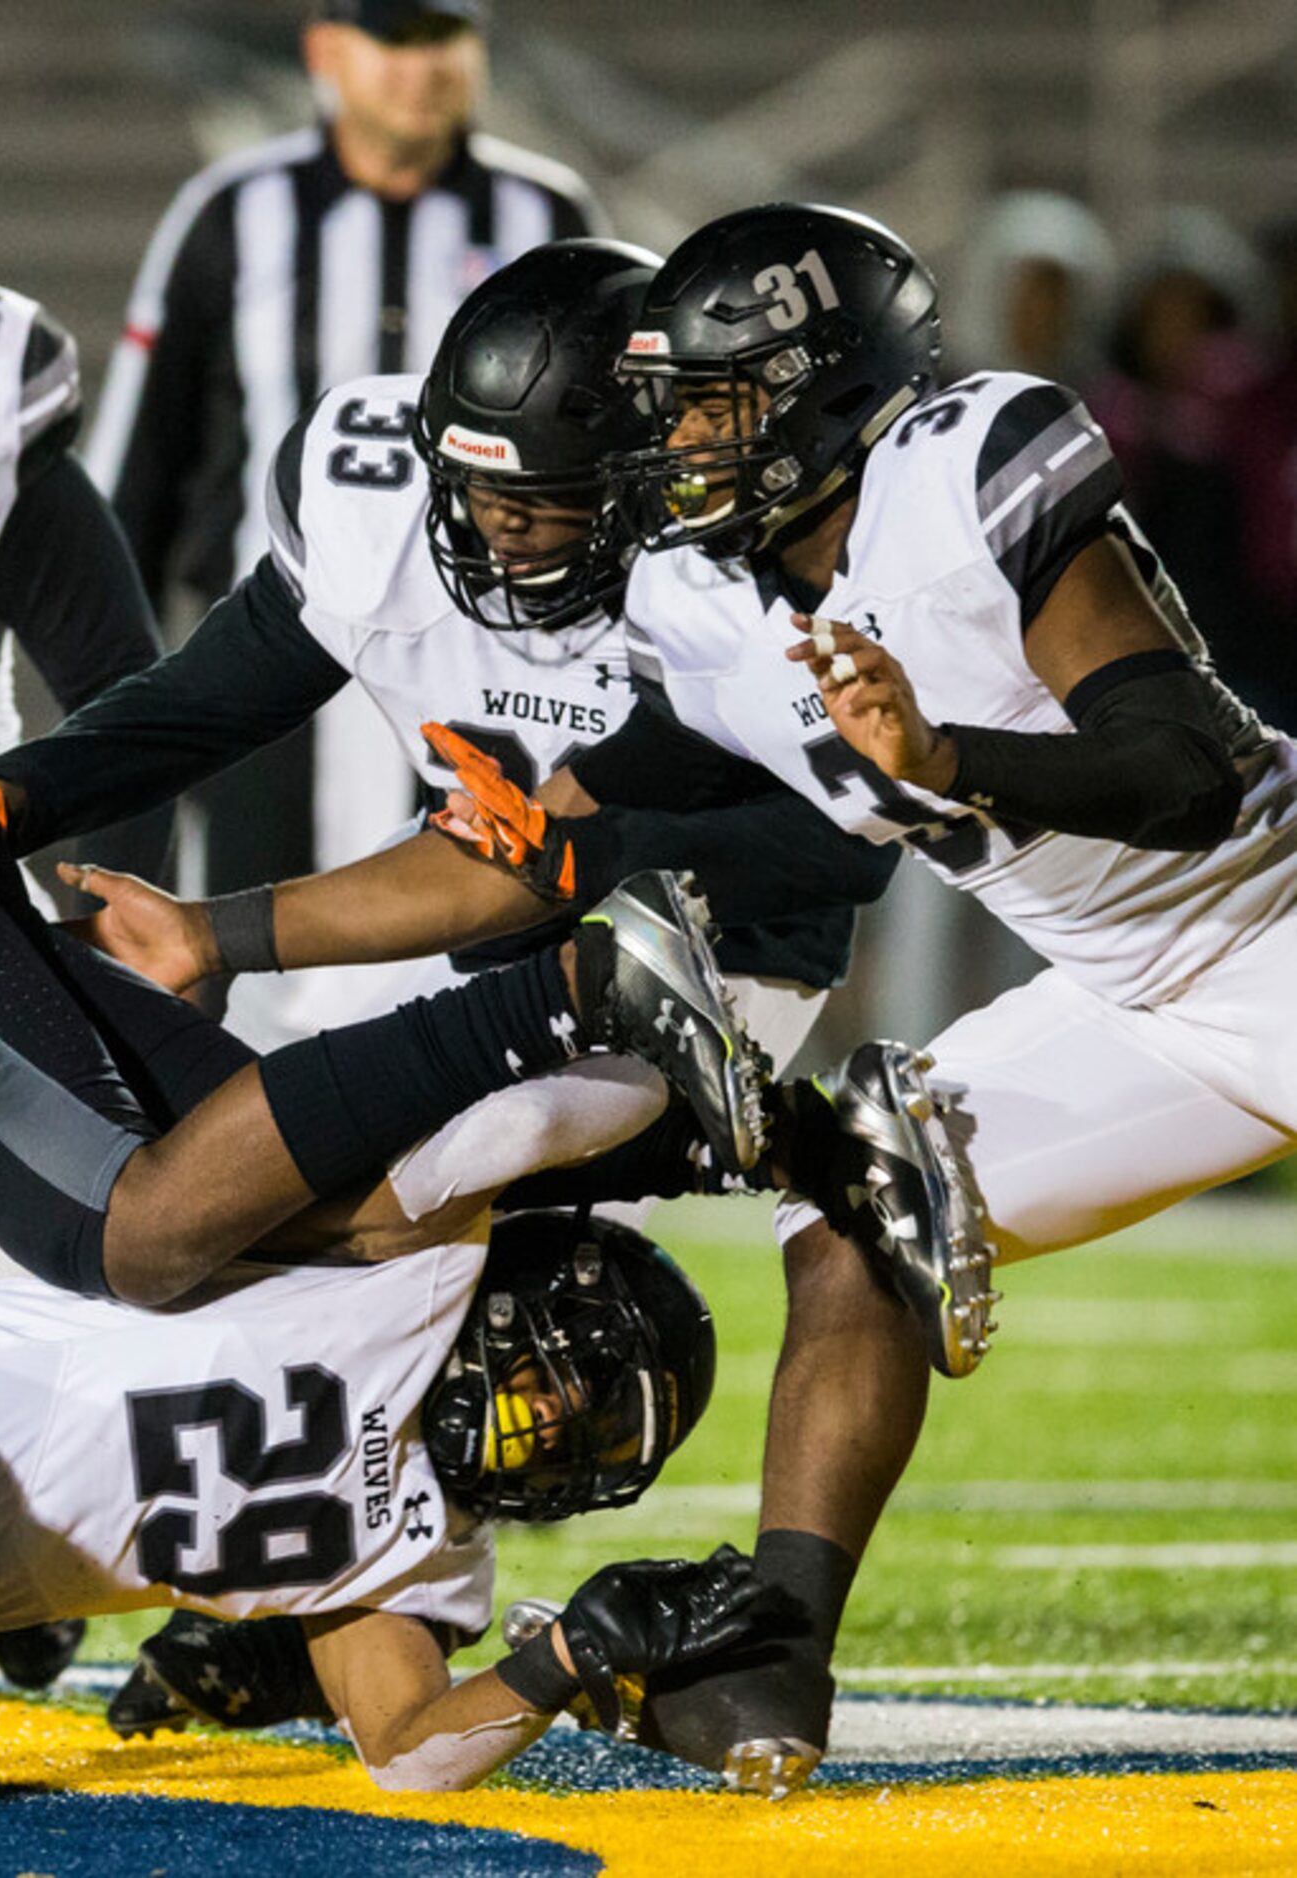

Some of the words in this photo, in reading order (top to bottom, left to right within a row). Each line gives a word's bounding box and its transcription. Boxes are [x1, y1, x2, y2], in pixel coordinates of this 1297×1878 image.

[753, 249, 840, 331] 31
[327, 398, 417, 491] 33
[482, 689, 607, 735] WOLVES
[125, 1362, 357, 1597] 29
[361, 1404, 393, 1530] WOLVES
